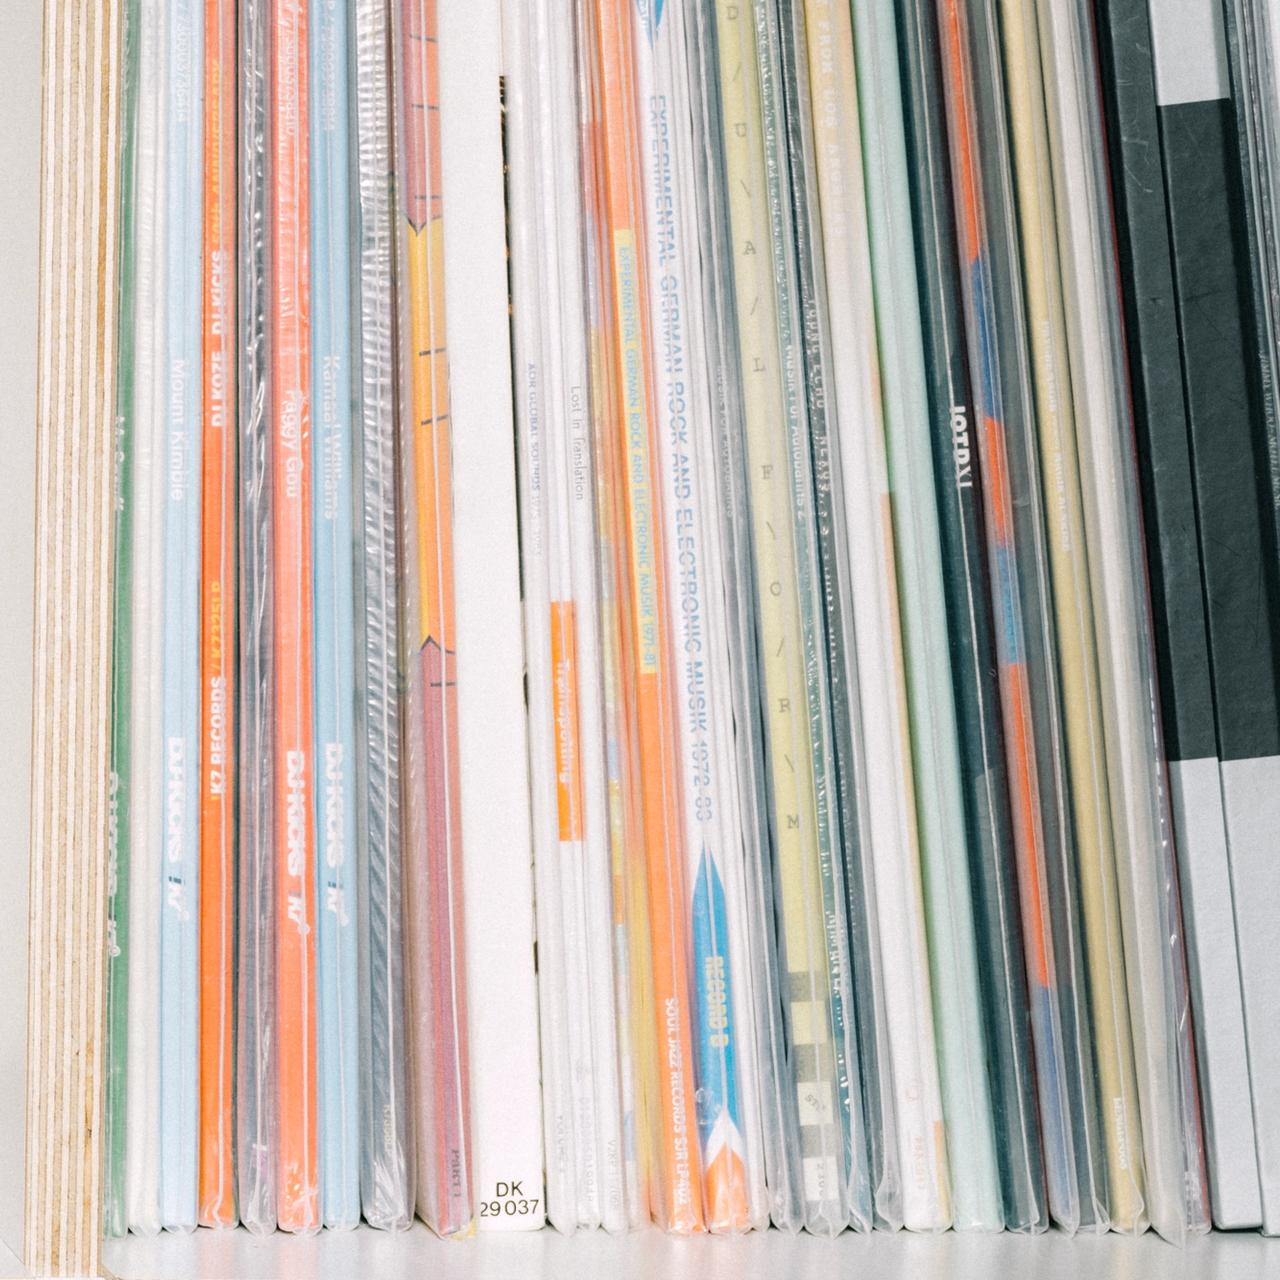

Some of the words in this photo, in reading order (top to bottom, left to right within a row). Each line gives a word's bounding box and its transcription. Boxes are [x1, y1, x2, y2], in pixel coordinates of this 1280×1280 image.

[647, 94, 677, 268] EXPERIMENTAL
[617, 245, 637, 345] EXPERIMENTAL
[657, 275, 683, 373] GERMAN
[624, 347, 640, 406] GERMAN
[627, 411, 644, 451] ROCK
[667, 380, 689, 445] ROCK
[571, 436, 587, 502] Translation
[630, 454, 646, 484] AND
[669, 452, 692, 500] AND
[631, 487, 651, 568] ELECTRONIC
[636, 572, 653, 618] MUSIK
[674, 507, 703, 654] ELECTRONIC
[685, 660, 708, 732] MUSIK
[667, 1070, 684, 1133] RECORDS
[496, 1181, 524, 1197] DK
